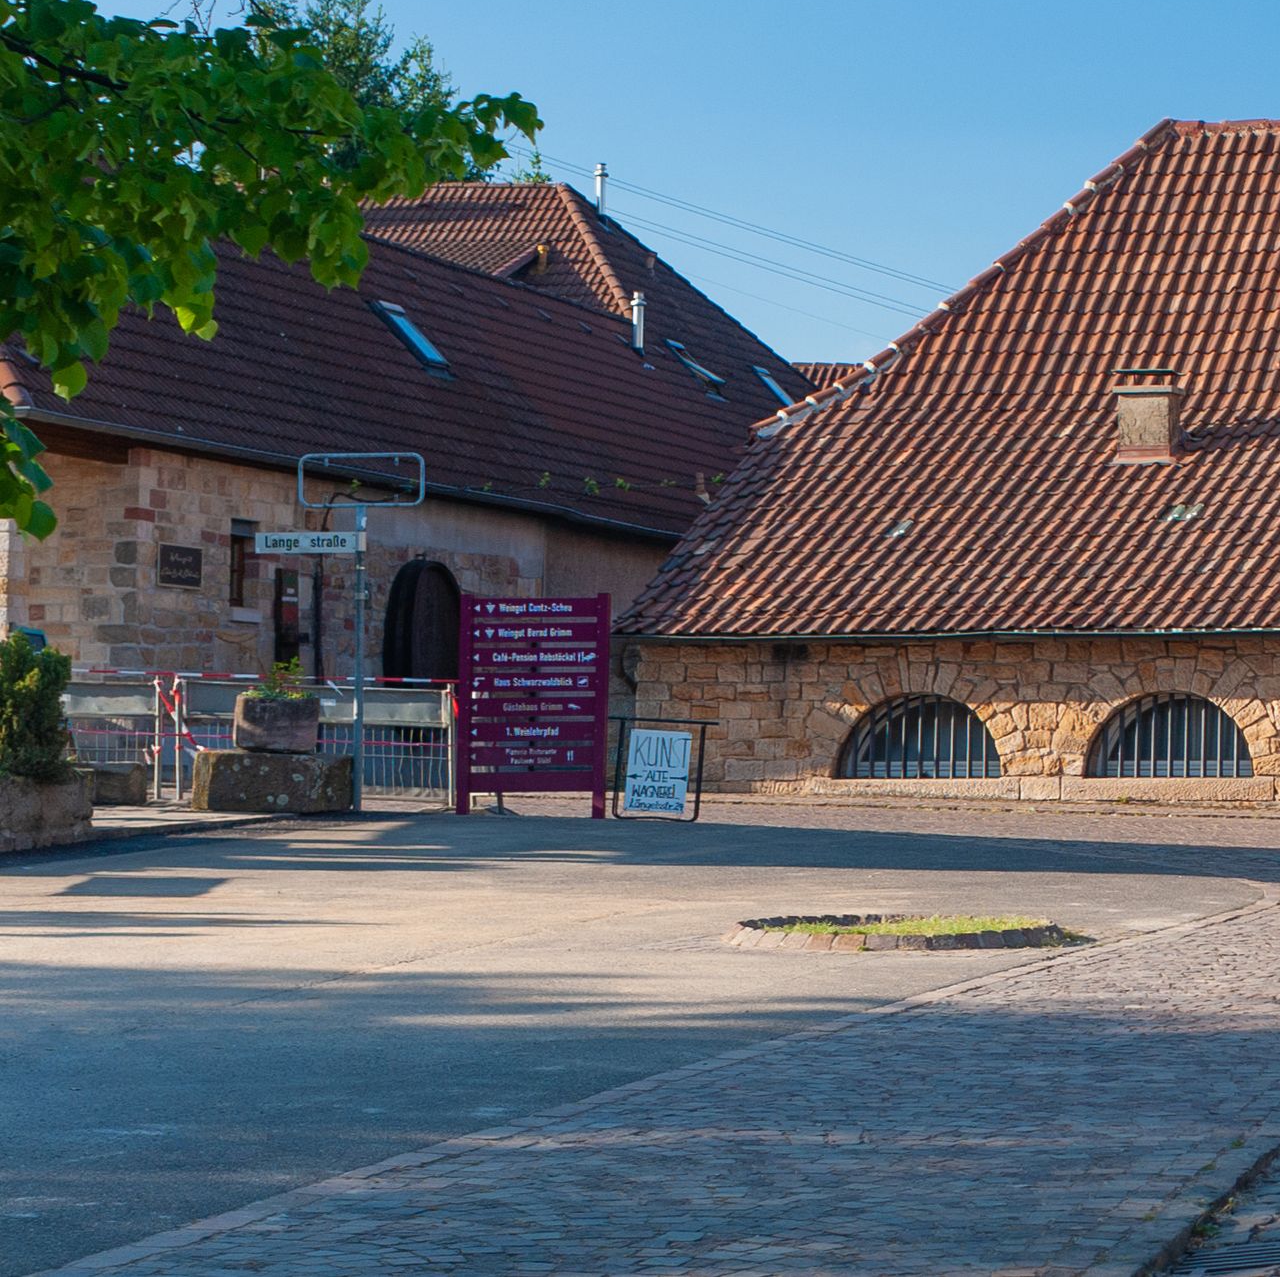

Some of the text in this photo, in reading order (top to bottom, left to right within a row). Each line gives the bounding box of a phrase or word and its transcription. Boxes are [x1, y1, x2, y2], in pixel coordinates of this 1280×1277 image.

[264, 534, 347, 551] Lange straße
[499, 603, 526, 614] Weingut
[498, 627, 573, 639] Weingut Bernd Grimm
[494, 678, 511, 687] Haus
[540, 702, 563, 711] Grimm
[634, 735, 692, 769] KUNST
[645, 770, 669, 782] ALTE
